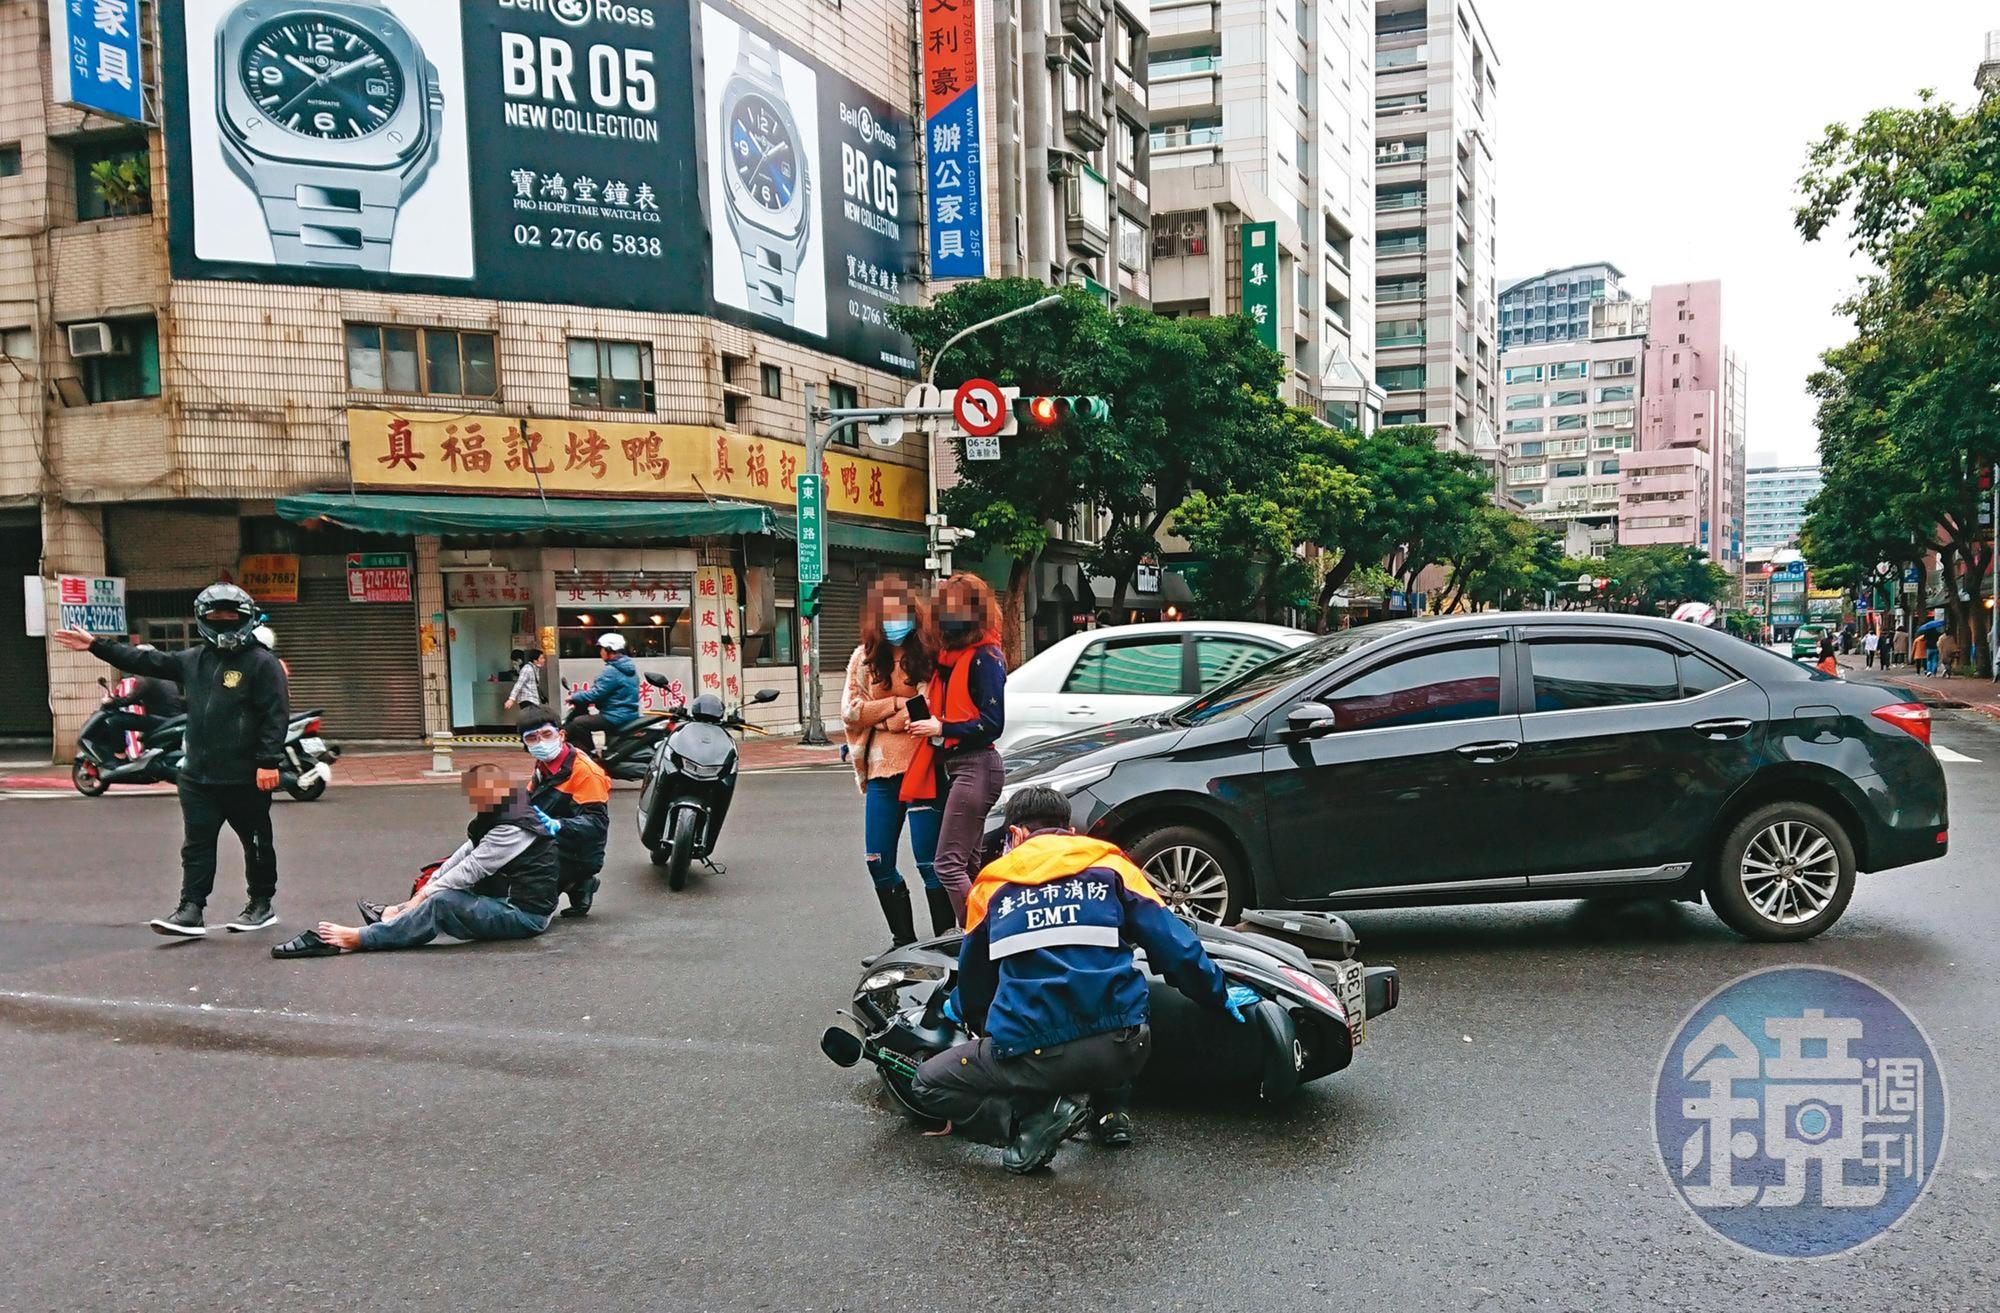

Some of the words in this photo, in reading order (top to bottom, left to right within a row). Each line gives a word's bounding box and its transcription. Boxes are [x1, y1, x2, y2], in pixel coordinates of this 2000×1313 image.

[596, 0, 655, 26] Ross
[307, 32, 335, 52] 12
[261, 65, 283, 85] 9
[501, 31, 577, 103] BR
[588, 43, 656, 111] 05
[313, 112, 336, 131] 6
[504, 102, 547, 128] NEW
[551, 107, 659, 142] COLLECTION
[840, 101, 857, 128] Bell
[874, 122, 896, 150] Ross
[511, 168, 659, 211] 寶鴻堂鐘表
[842, 141, 870, 205] BR
[873, 159, 898, 217] 05
[933, 123, 964, 260] 辦公家具
[513, 198, 537, 210] PRO
[539, 200, 599, 217] HOPETIME
[600, 207, 641, 221] WATCH
[844, 199, 860, 224] NEW
[860, 207, 899, 241] COLLECTION
[514, 224, 541, 246] 02
[550, 227, 603, 251] 2766
[612, 233, 662, 257] 5838
[970, 229, 981, 258] 2/5F
[849, 298, 860, 318] 02
[862, 304, 881, 325] 2766
[377, 418, 671, 480] 真福記烤鴨
[967, 438, 998, 447] 06-24
[802, 486, 816, 540] 東興路
[61, 577, 87, 604] 售
[365, 570, 408, 589] 2747-1122
[63, 605, 125, 632] 0932-322218
[699, 578, 721, 690] 脆皮烤鴨
[998, 880, 1110, 919] 臺北市消防
[1025, 904, 1081, 929] EMT
